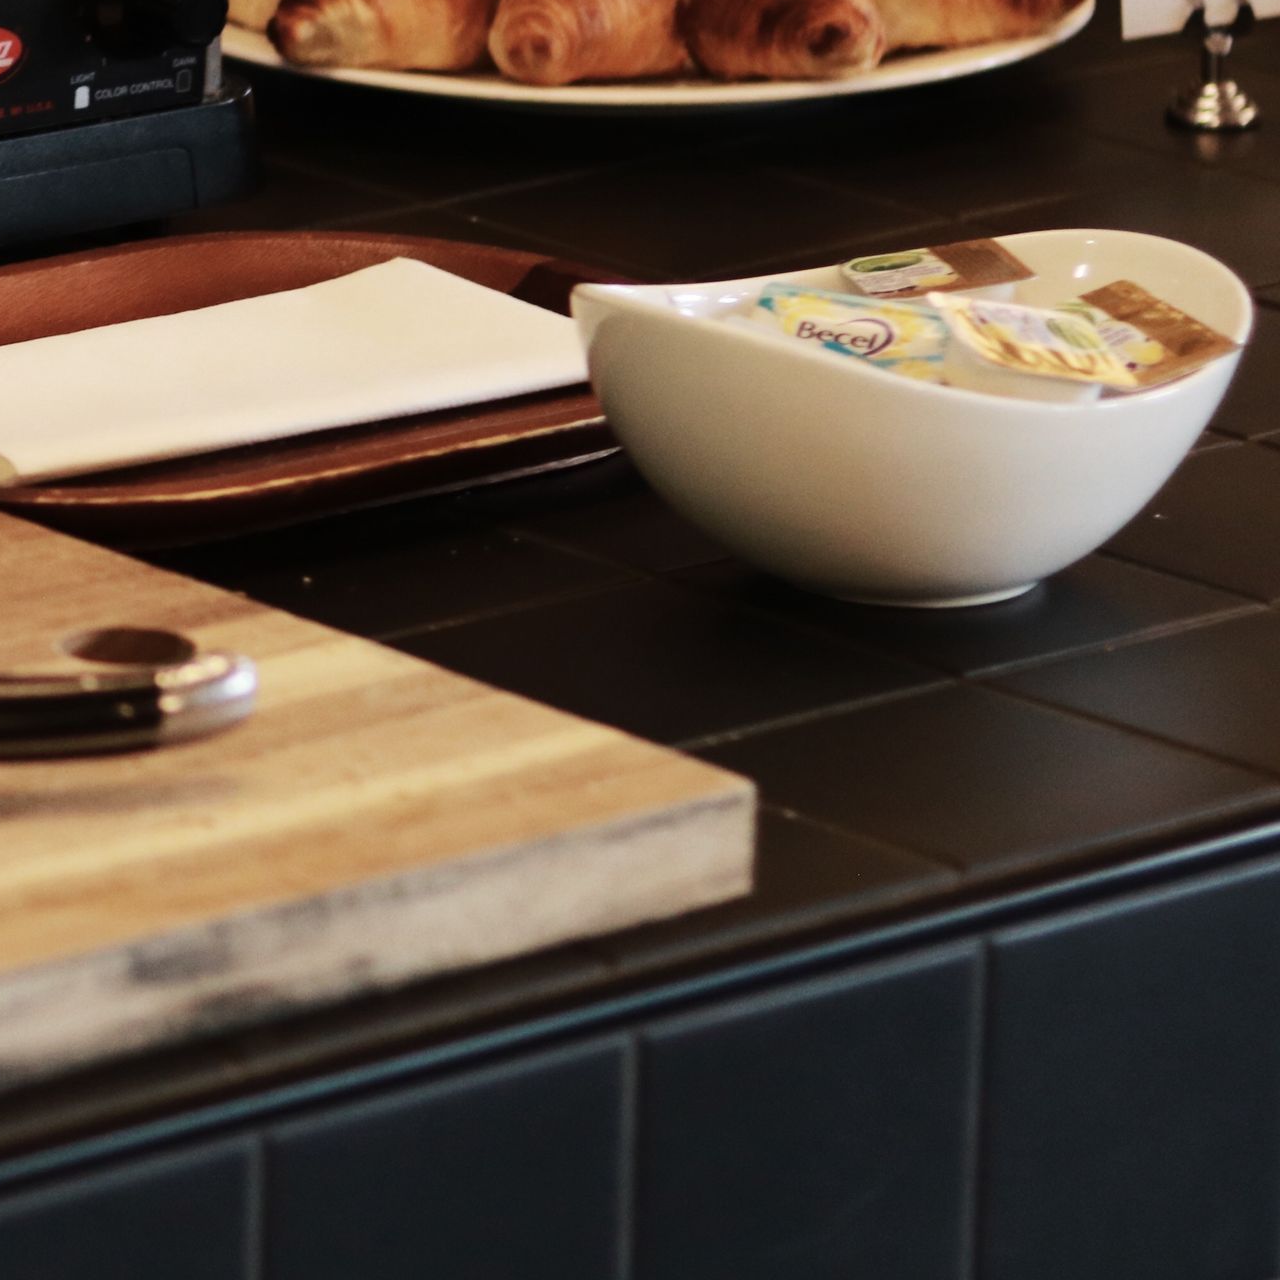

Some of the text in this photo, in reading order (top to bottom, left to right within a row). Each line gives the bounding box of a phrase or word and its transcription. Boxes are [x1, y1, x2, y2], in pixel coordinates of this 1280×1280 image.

[70, 71, 96, 85] LIGHT
[95, 78, 174, 100] COLOR CONTROL
[796, 320, 878, 350] Becel
